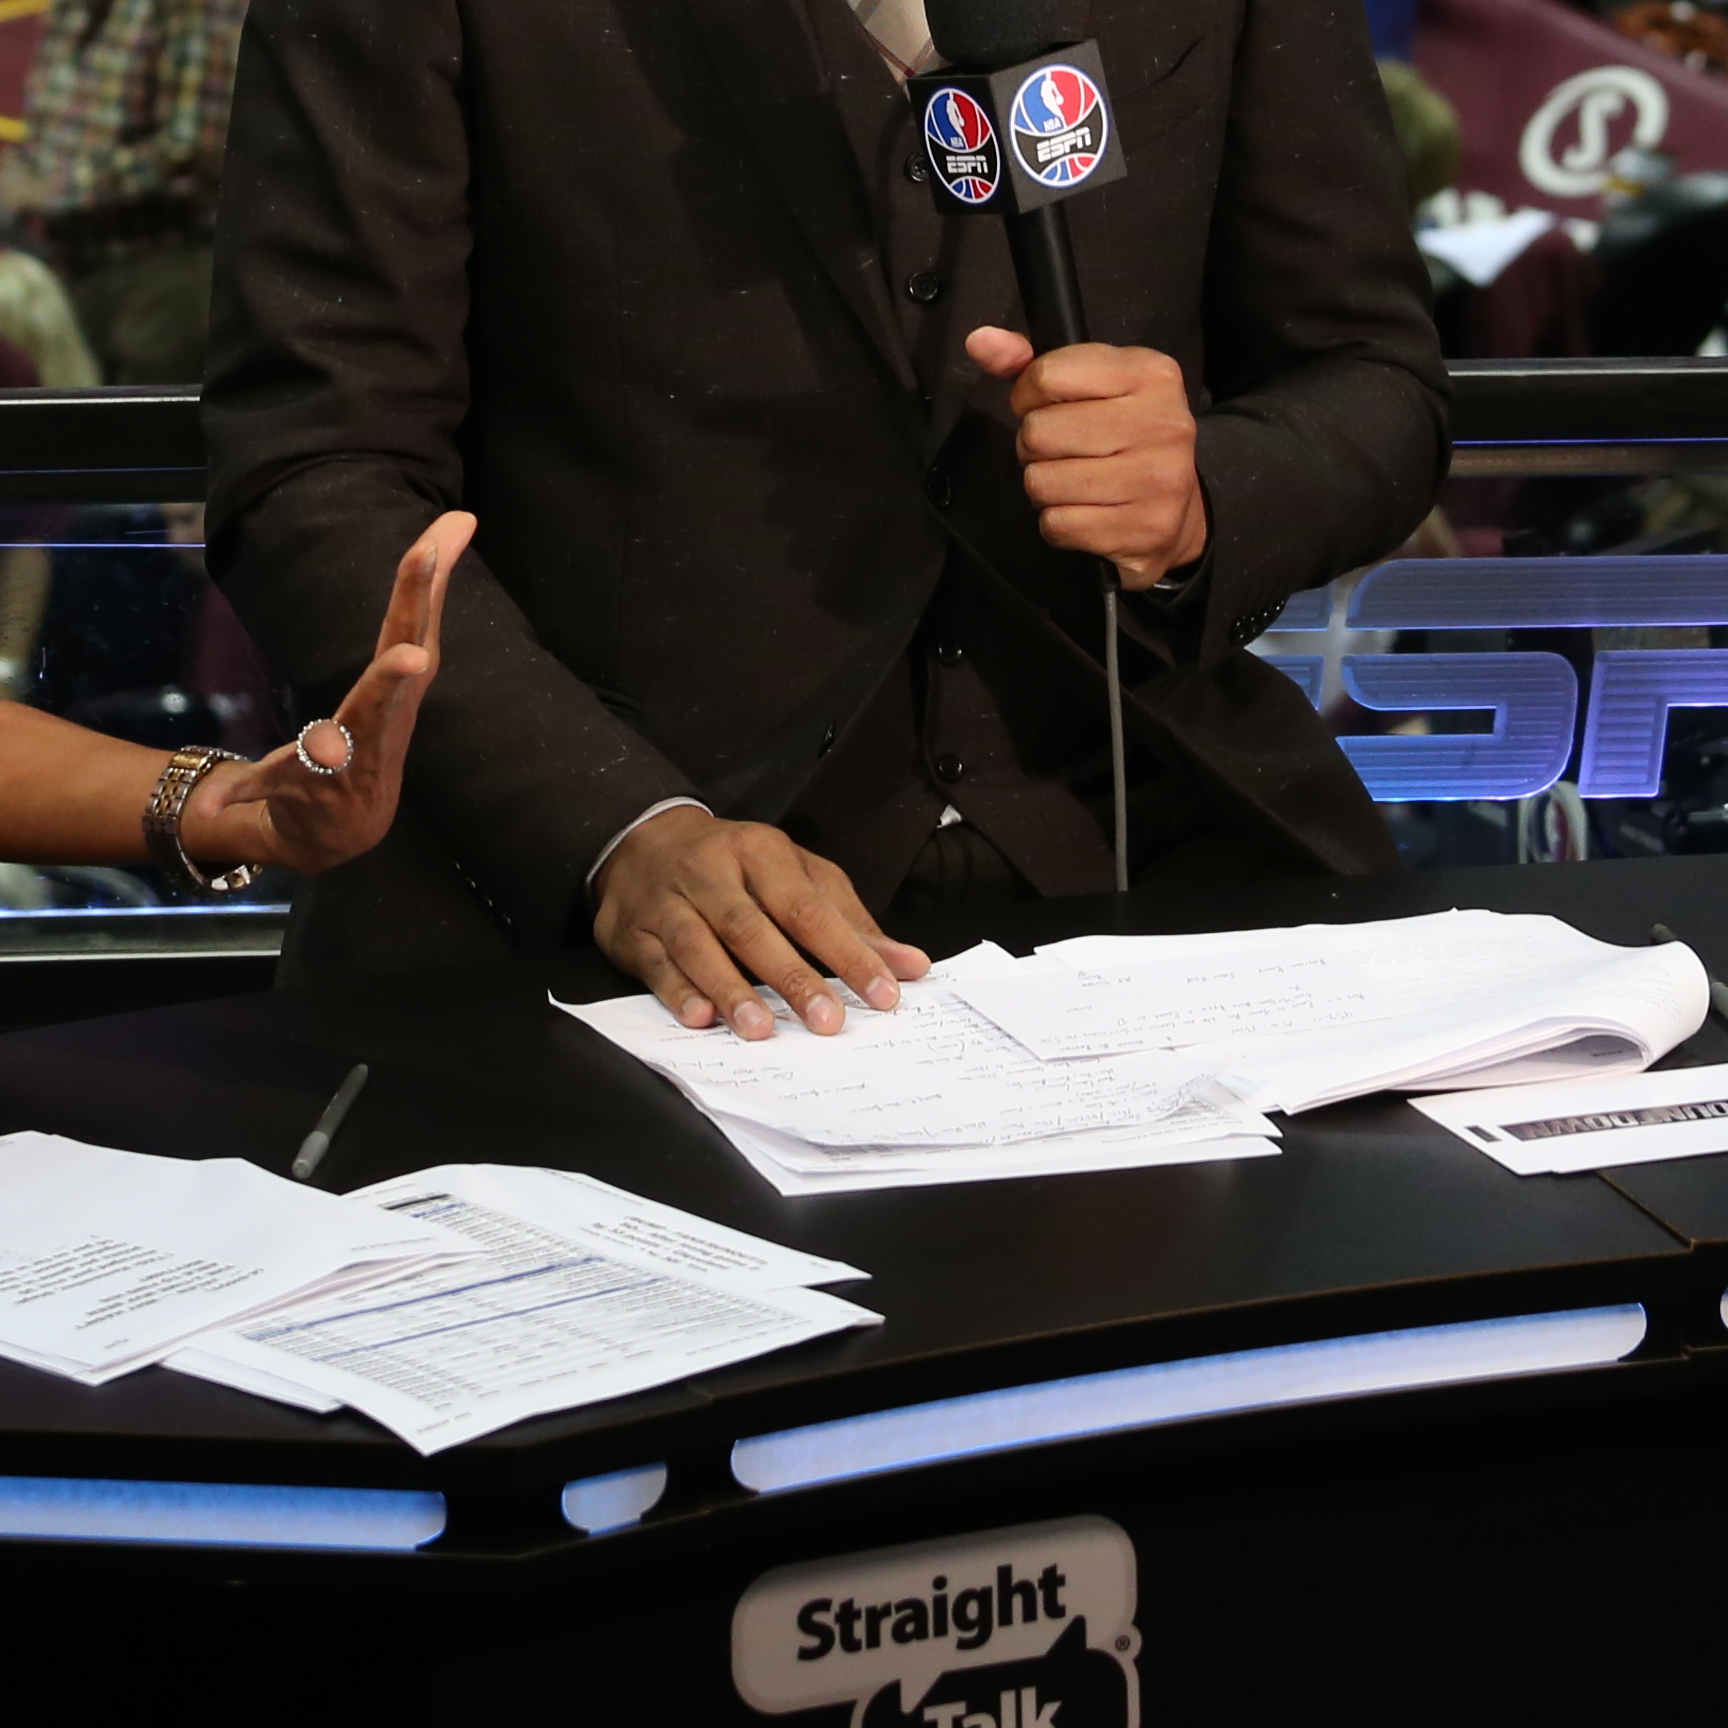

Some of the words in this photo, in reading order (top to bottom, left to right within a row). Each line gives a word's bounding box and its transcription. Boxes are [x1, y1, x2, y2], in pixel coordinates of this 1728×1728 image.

[1042, 116, 1062, 133] NBA
[1036, 126, 1092, 163] ESPN
[945, 154, 989, 174] ESPN
[796, 1562, 1068, 1662] Straight
